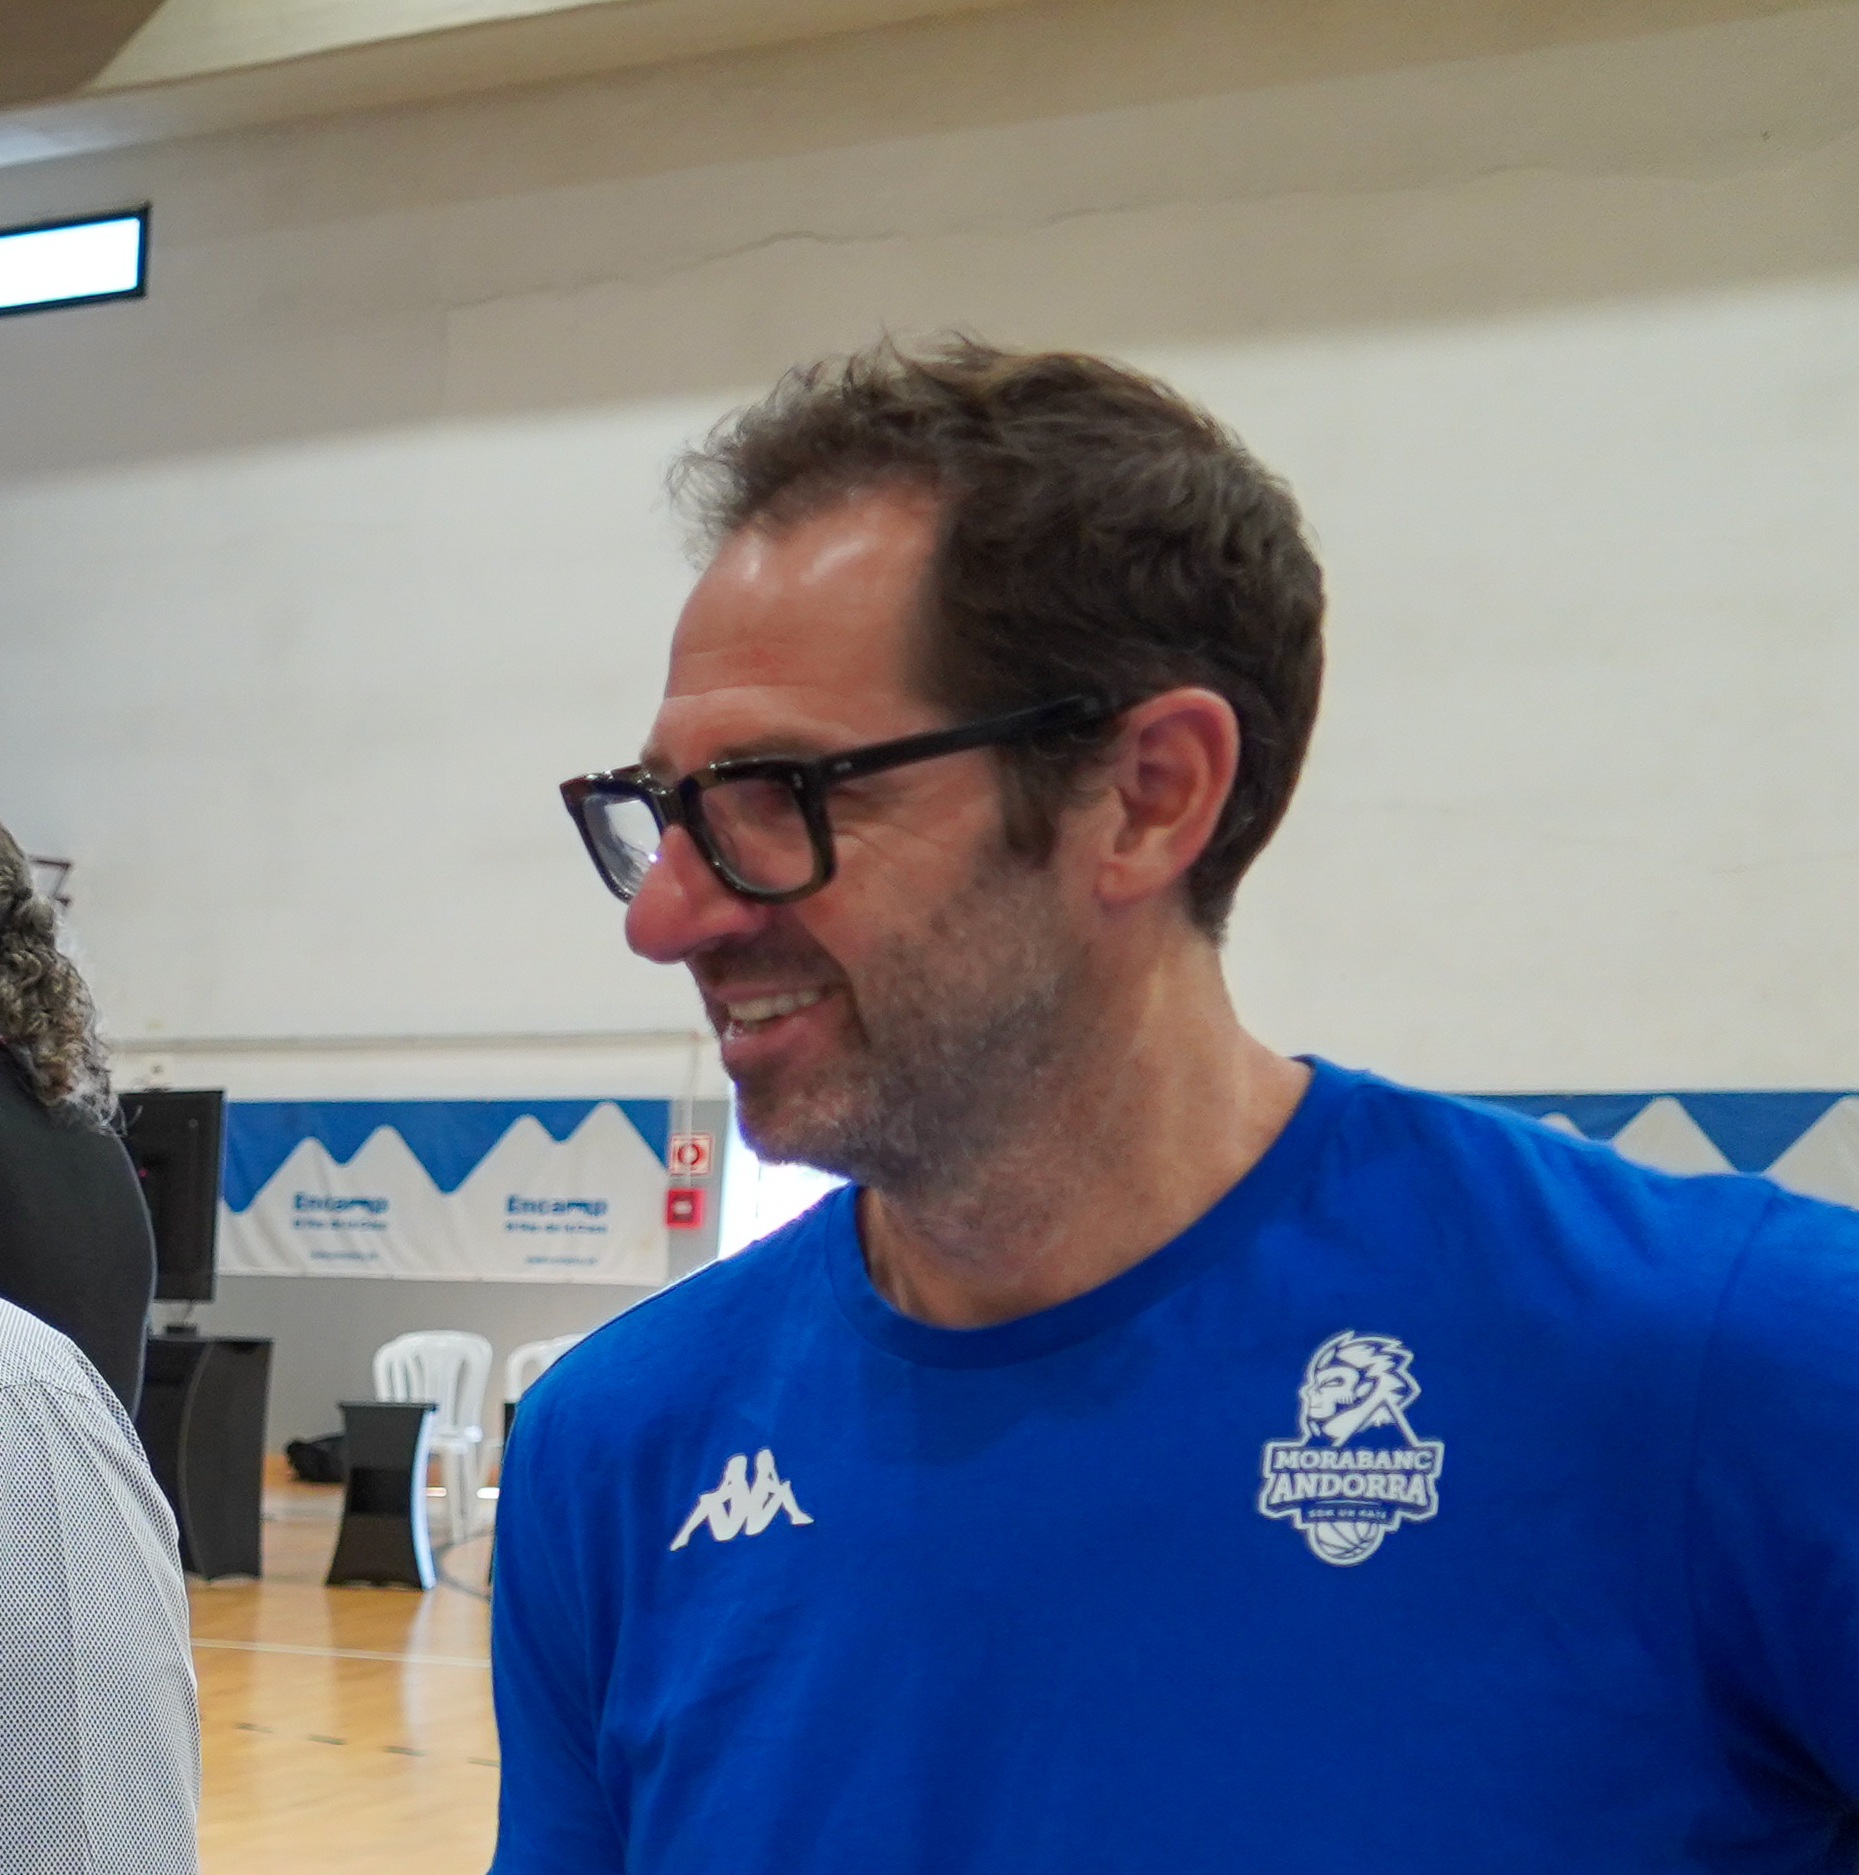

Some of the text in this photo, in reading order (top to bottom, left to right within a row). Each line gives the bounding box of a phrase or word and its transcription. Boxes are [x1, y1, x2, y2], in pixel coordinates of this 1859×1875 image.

[508, 1195, 608, 1216] Encamp
[1273, 1449, 1434, 1470] MORABANC
[1269, 1472, 1429, 1507] ANDORRA
